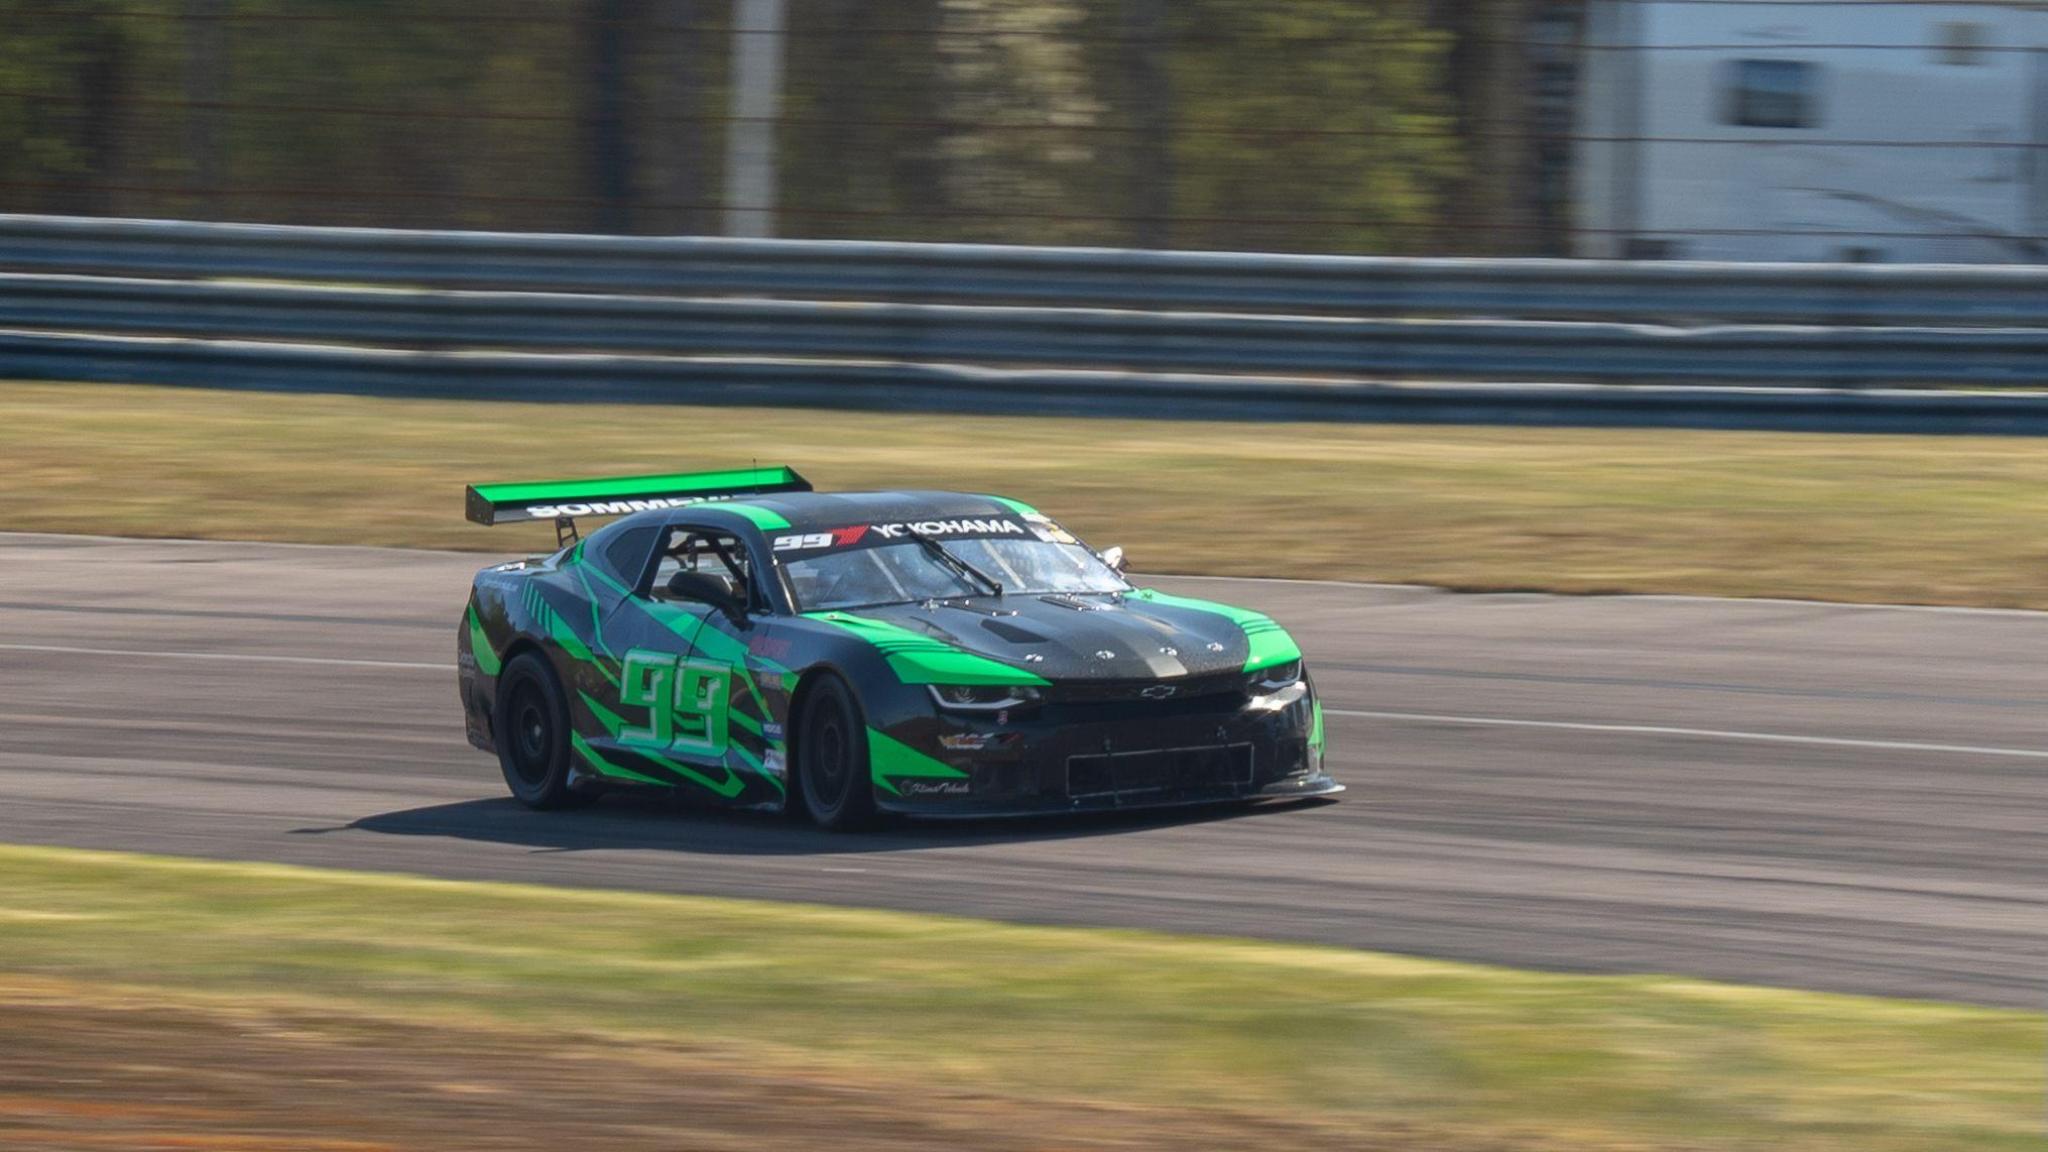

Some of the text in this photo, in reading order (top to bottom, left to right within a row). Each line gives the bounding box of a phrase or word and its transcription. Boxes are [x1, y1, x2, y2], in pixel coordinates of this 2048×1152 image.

[871, 519, 1024, 538] YOKOHAMA
[772, 533, 834, 551] 99
[616, 647, 733, 758] 99
